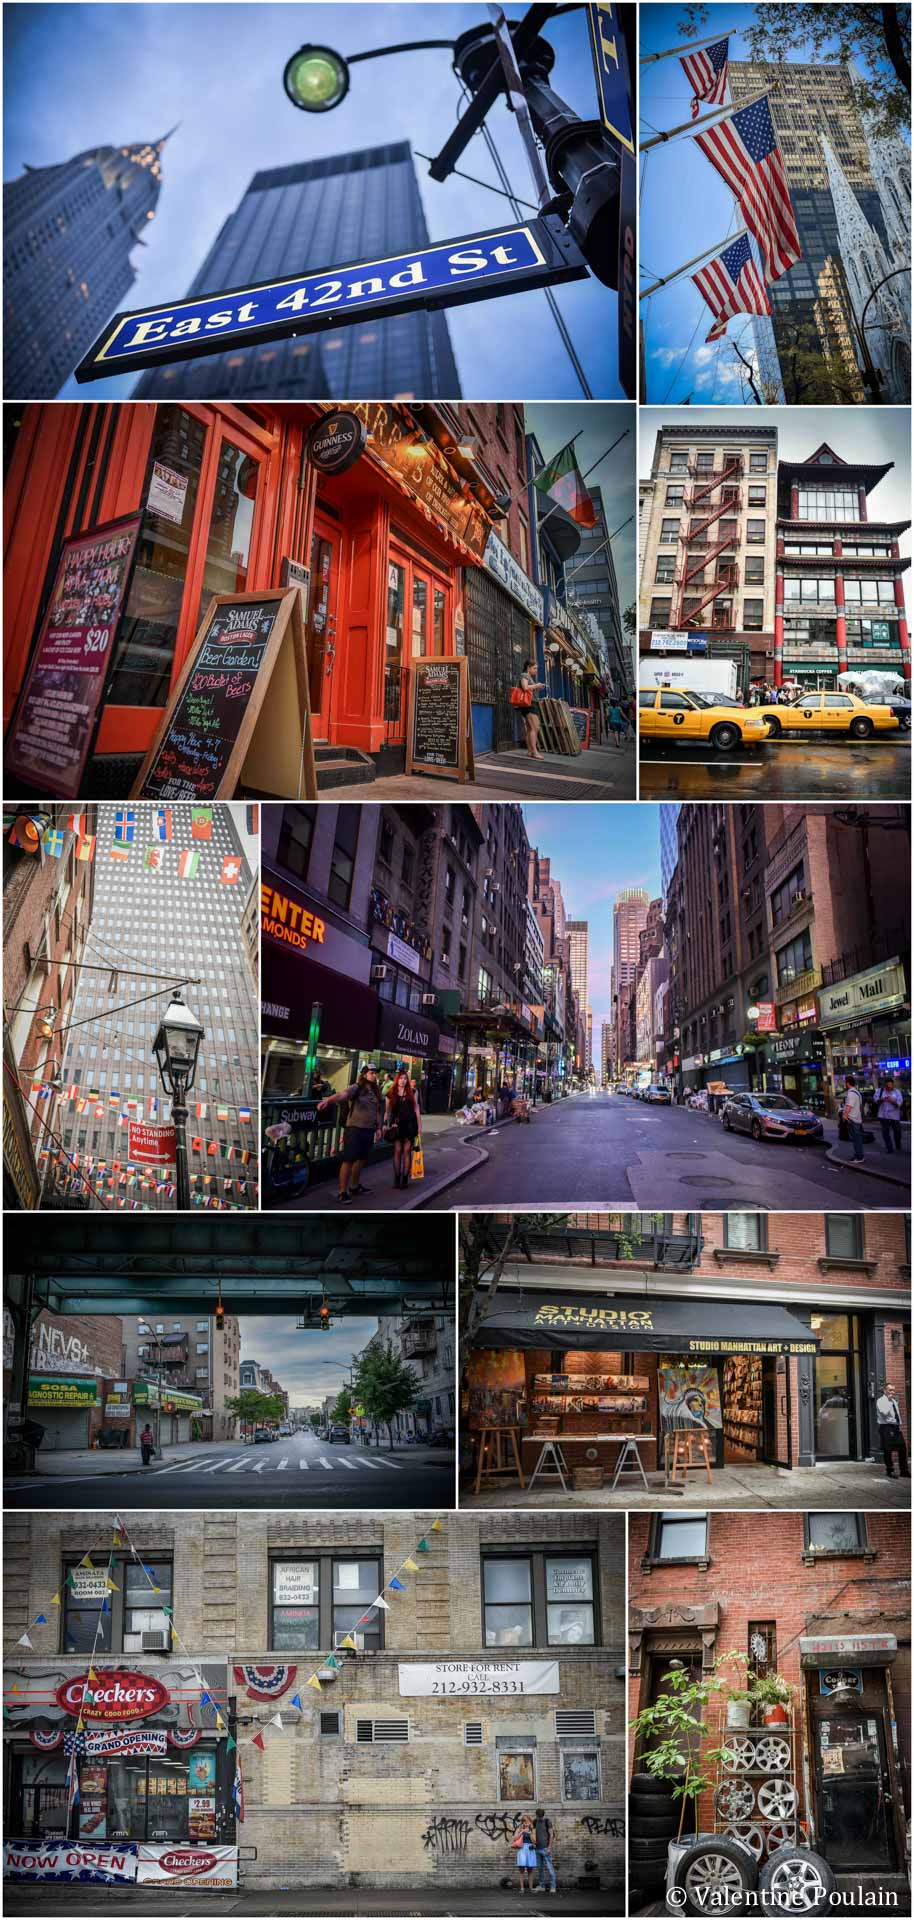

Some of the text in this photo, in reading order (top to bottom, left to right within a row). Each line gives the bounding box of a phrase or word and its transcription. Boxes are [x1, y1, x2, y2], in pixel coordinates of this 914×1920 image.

[123, 245, 518, 348] East 42nd St
[313, 431, 353, 452] GUINNESS
[227, 608, 265, 622] SAMUEL
[224, 619, 258, 633] ADAMS
[84, 627, 109, 655] $20
[200, 647, 222, 665] Beer
[829, 979, 883, 1010] Jewel Mall
[397, 1024, 429, 1046] ZOLAND
[775, 1038, 795, 1052] LEON
[281, 1109, 317, 1122] Subway
[131, 1126, 175, 1138] NO STANDING
[132, 1134, 159, 1146] Anytime
[538, 1305, 651, 1320] STUDIO
[535, 1313, 653, 1327] MANHATTAN
[689, 1340, 719, 1351] STUDIO
[720, 1341, 767, 1352] MANHATTAN
[767, 1343, 782, 1353] ART
[789, 1343, 817, 1353] DESIGN
[64, 1392, 89, 1400] REPAIR
[279, 1584, 311, 1592] BRAIDING
[435, 1663, 521, 1673] STORE FOR RENT
[467, 1673, 490, 1681] CALL
[66, 1683, 155, 1703] Checkers
[431, 1681, 525, 1694] 212-932-8331
[83, 1708, 102, 1717] CRAZY
[122, 1708, 140, 1716] FOOD
[87, 1733, 165, 1752] GRAND OPENING
[6, 1852, 126, 1871] NOW OPEN
[163, 1855, 212, 1867] Checkers
